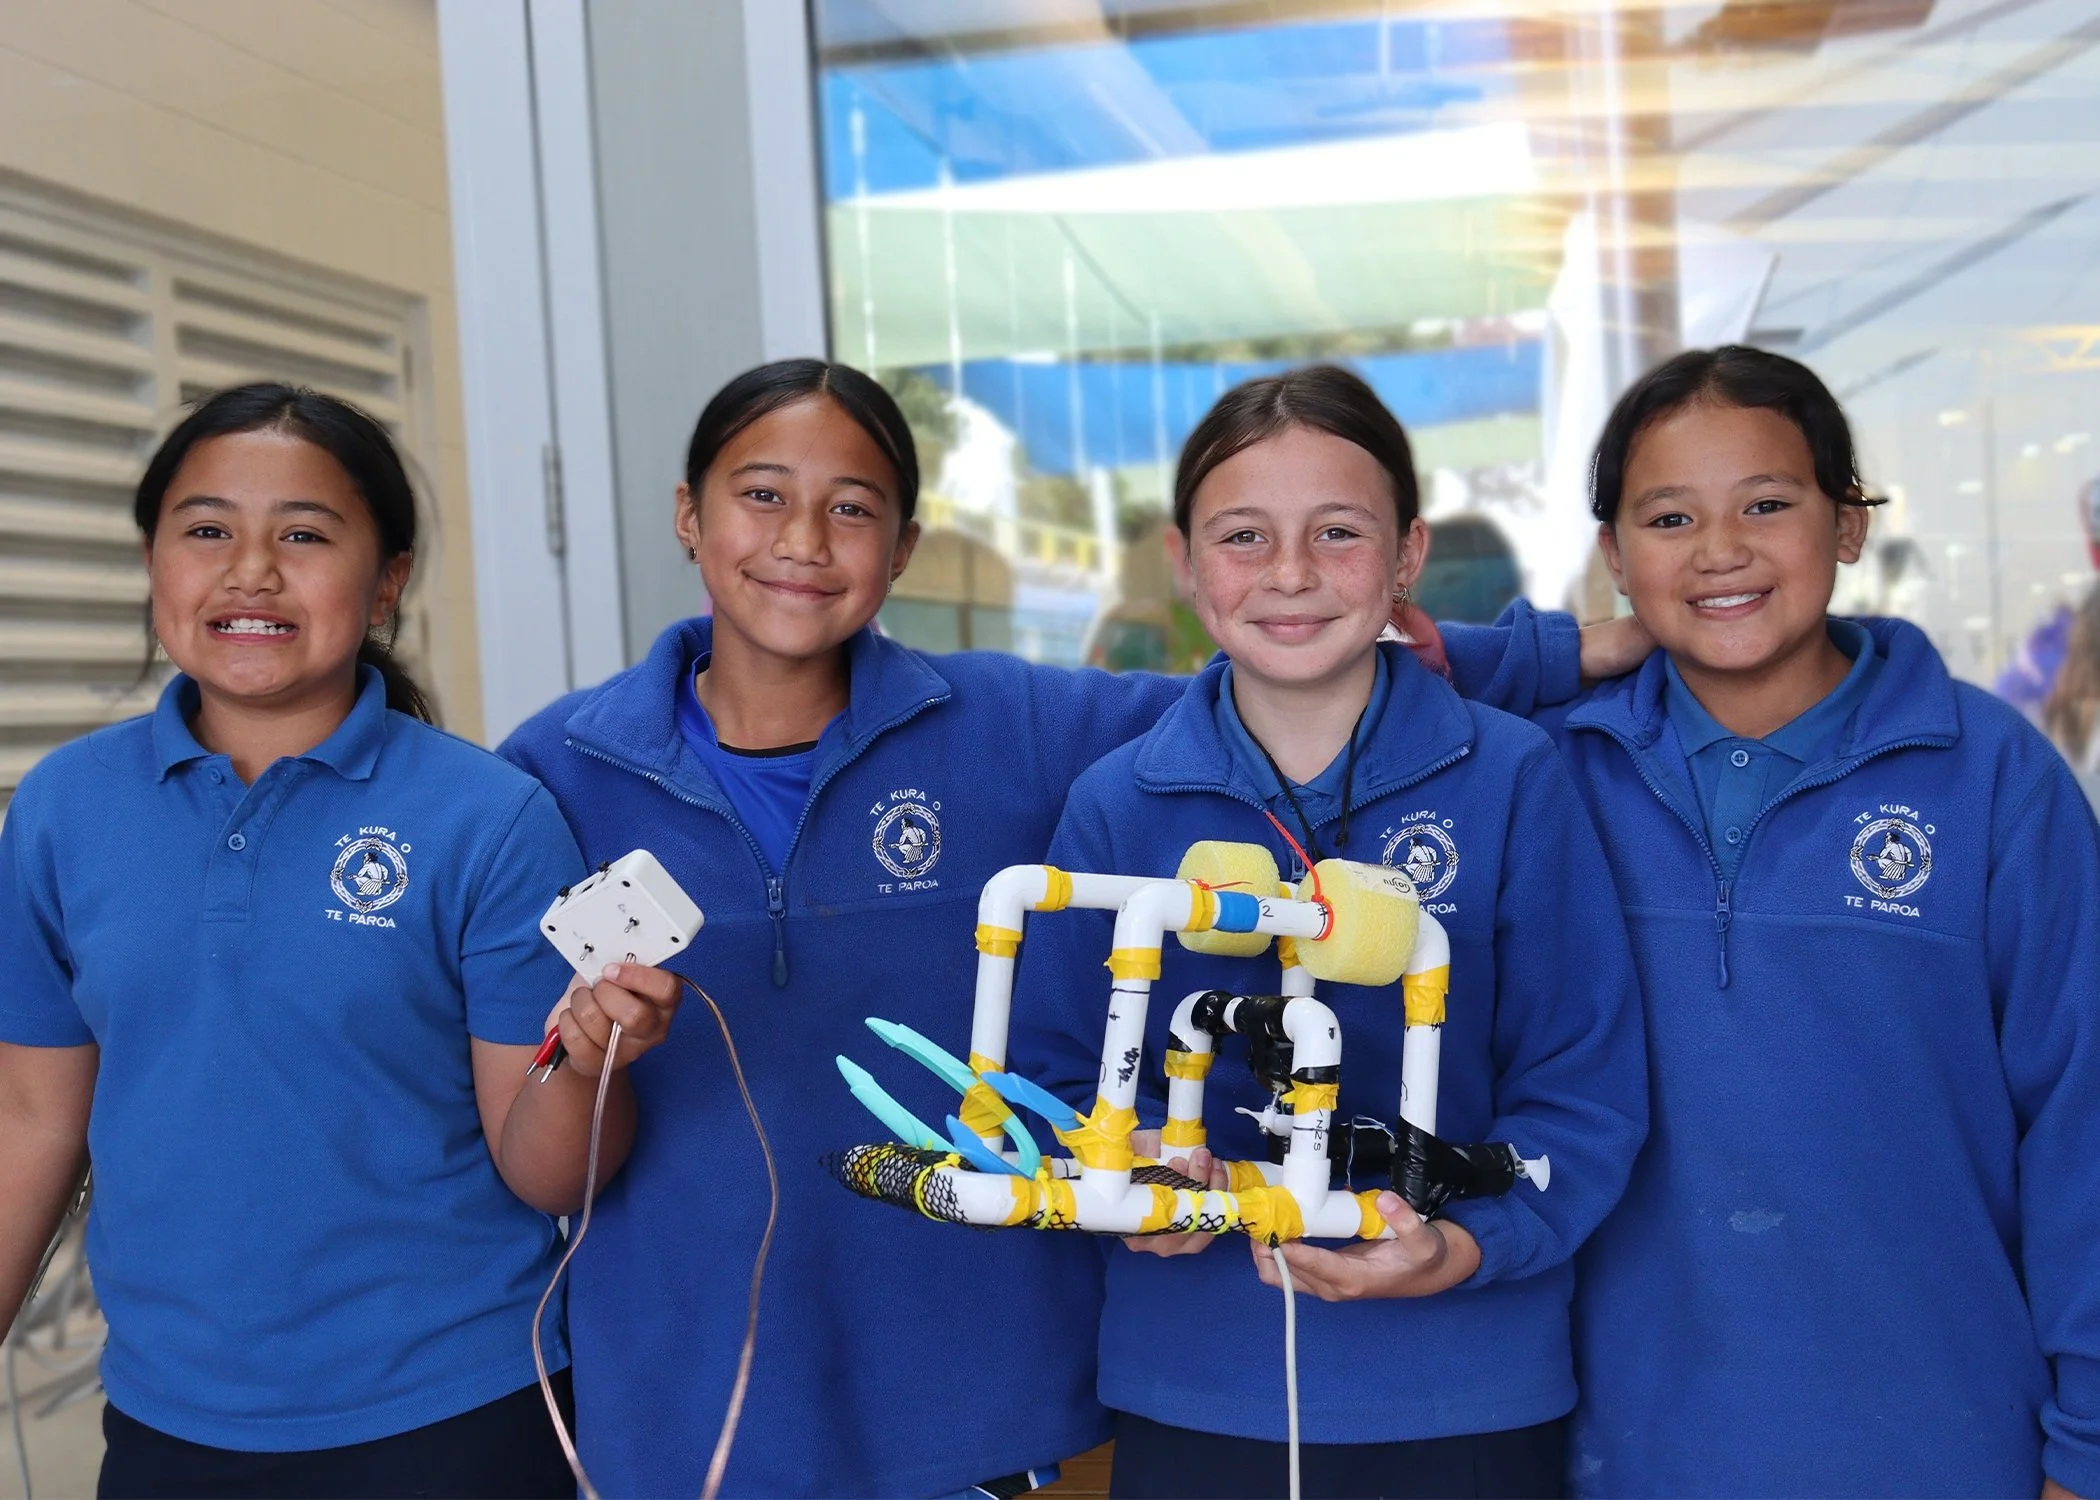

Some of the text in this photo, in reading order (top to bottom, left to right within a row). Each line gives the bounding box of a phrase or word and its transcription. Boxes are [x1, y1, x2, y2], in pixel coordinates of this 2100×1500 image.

[869, 789, 941, 816] TE KURA O
[1379, 810, 1453, 839] TE KURA O
[1854, 804, 1936, 835] TE KURA O
[334, 826, 411, 853] TE KURA O
[877, 880, 938, 893] TE PAROA
[1262, 905, 1274, 917] 2
[1419, 903, 1458, 914] AROA
[1844, 896, 1920, 918] TE PAROA
[325, 909, 396, 929] TE PAROA
